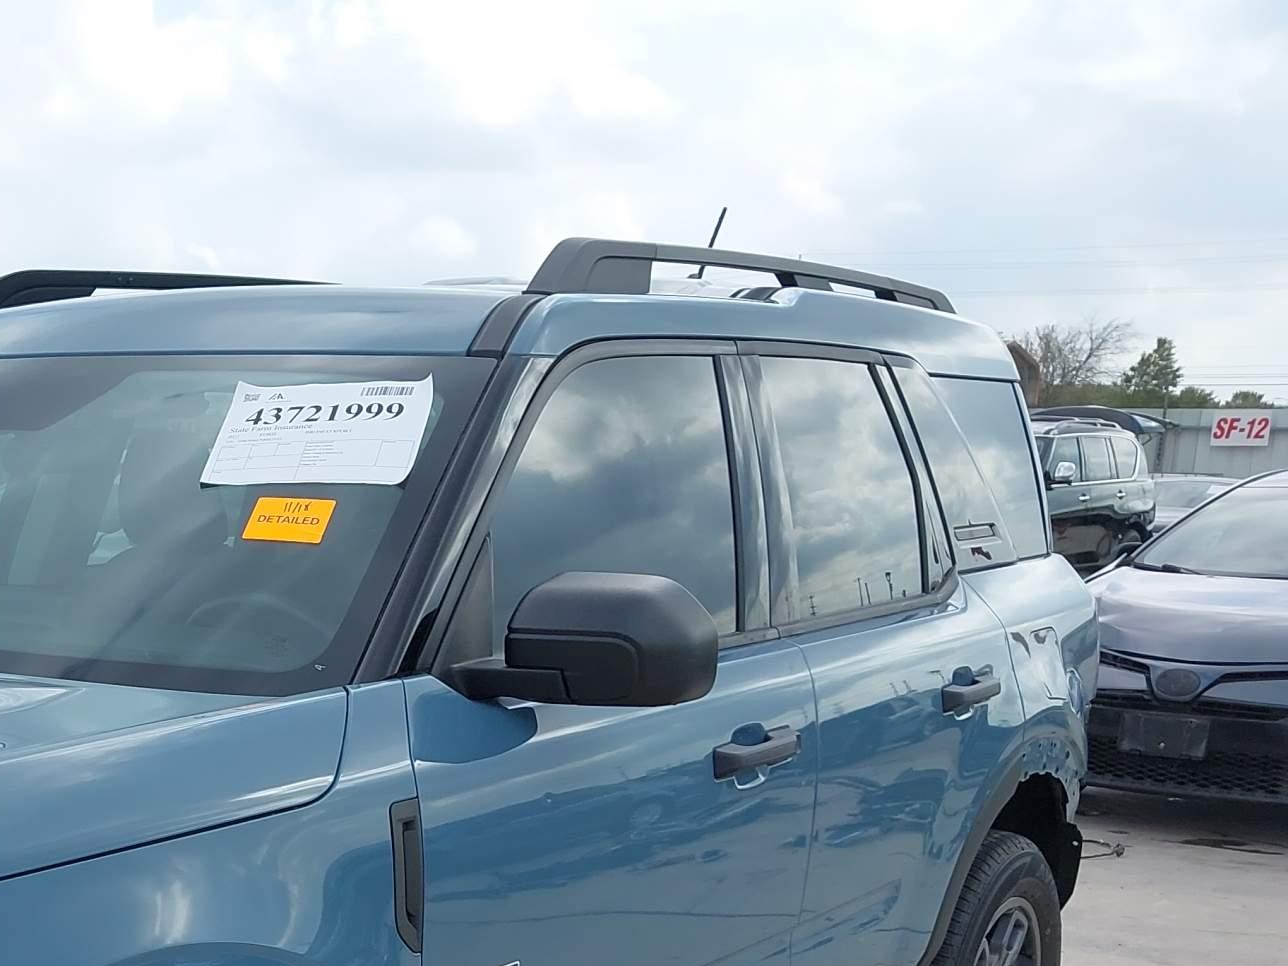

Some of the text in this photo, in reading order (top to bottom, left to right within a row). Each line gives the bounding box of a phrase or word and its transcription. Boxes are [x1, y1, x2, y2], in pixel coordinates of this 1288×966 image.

[245, 402, 406, 425] 43721999
[1213, 417, 1270, 439] SF-12
[257, 514, 320, 525] DETAILED
